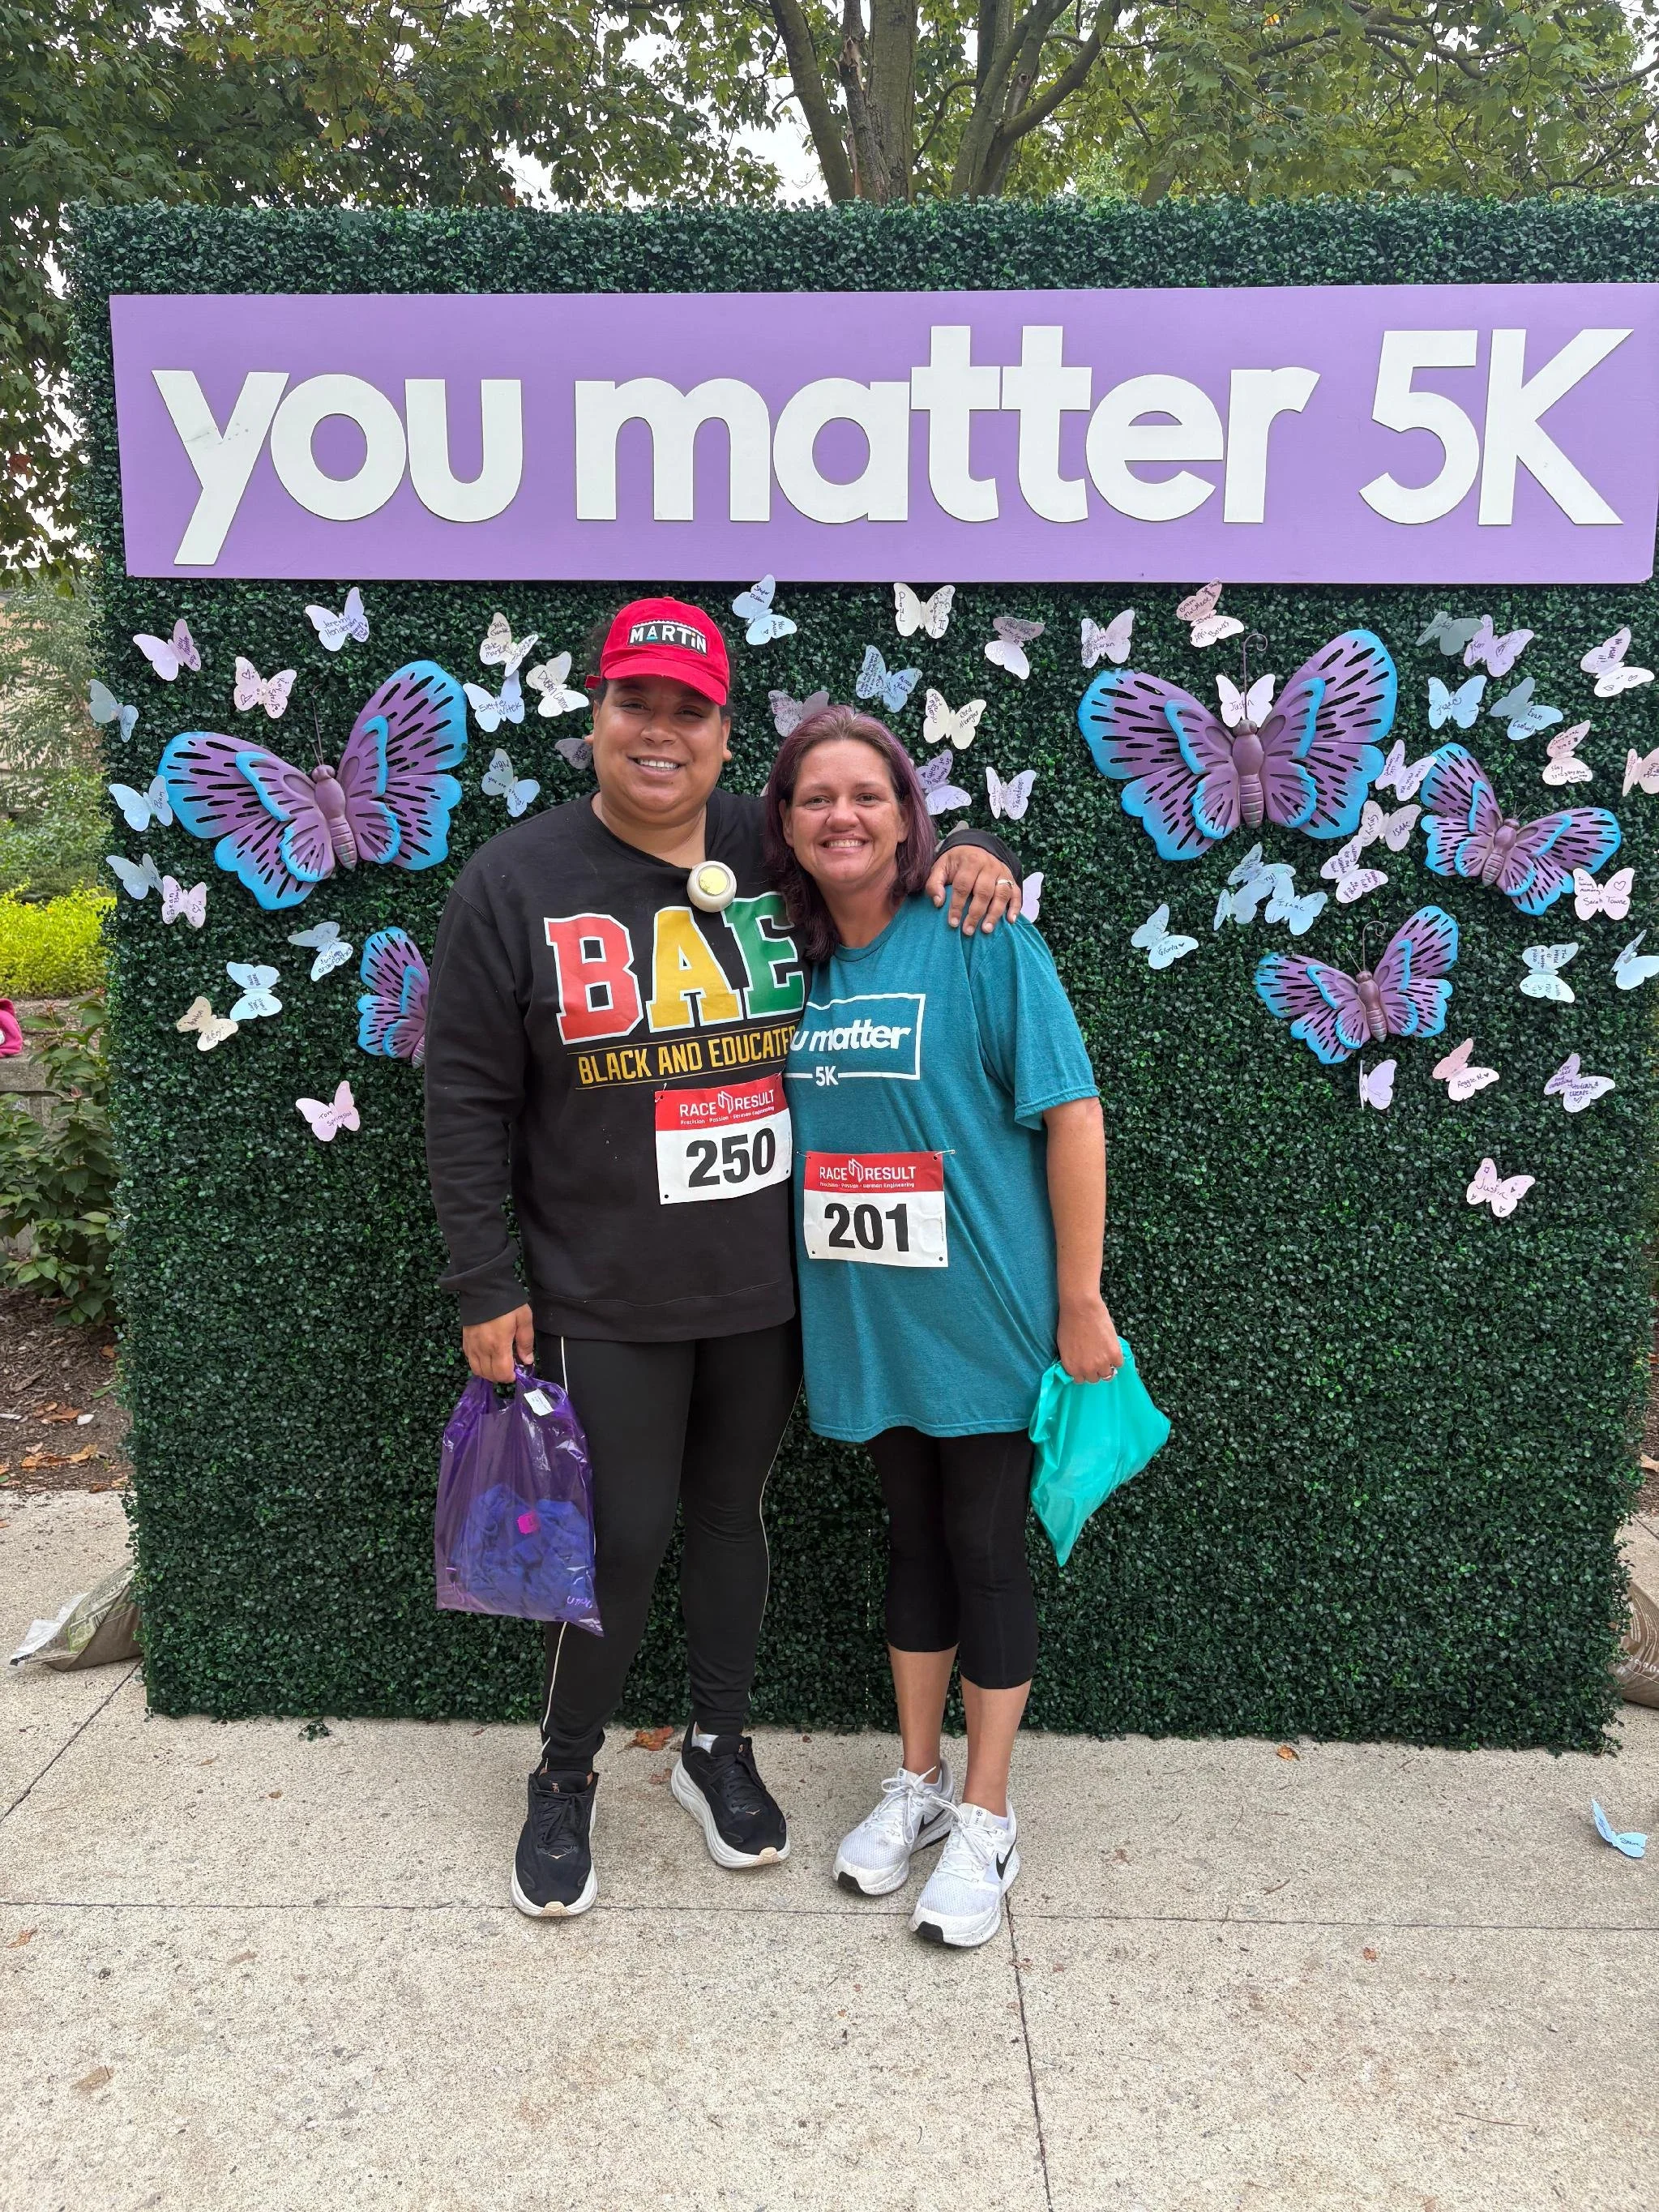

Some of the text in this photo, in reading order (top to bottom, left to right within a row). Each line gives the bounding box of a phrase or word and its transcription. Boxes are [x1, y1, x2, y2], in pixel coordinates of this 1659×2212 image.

[152, 325, 1635, 565] you matter 5K
[544, 891, 805, 1045] BAE
[808, 1019, 912, 1051] matter
[578, 1050, 652, 1085] BLACK
[656, 1042, 703, 1076] AND
[815, 1065, 839, 1086] 5K
[679, 1089, 774, 1117] RACE RESULT
[686, 1127, 776, 1188] 250
[819, 1166, 917, 1180] RACE RESULT
[824, 1203, 909, 1252] 201
